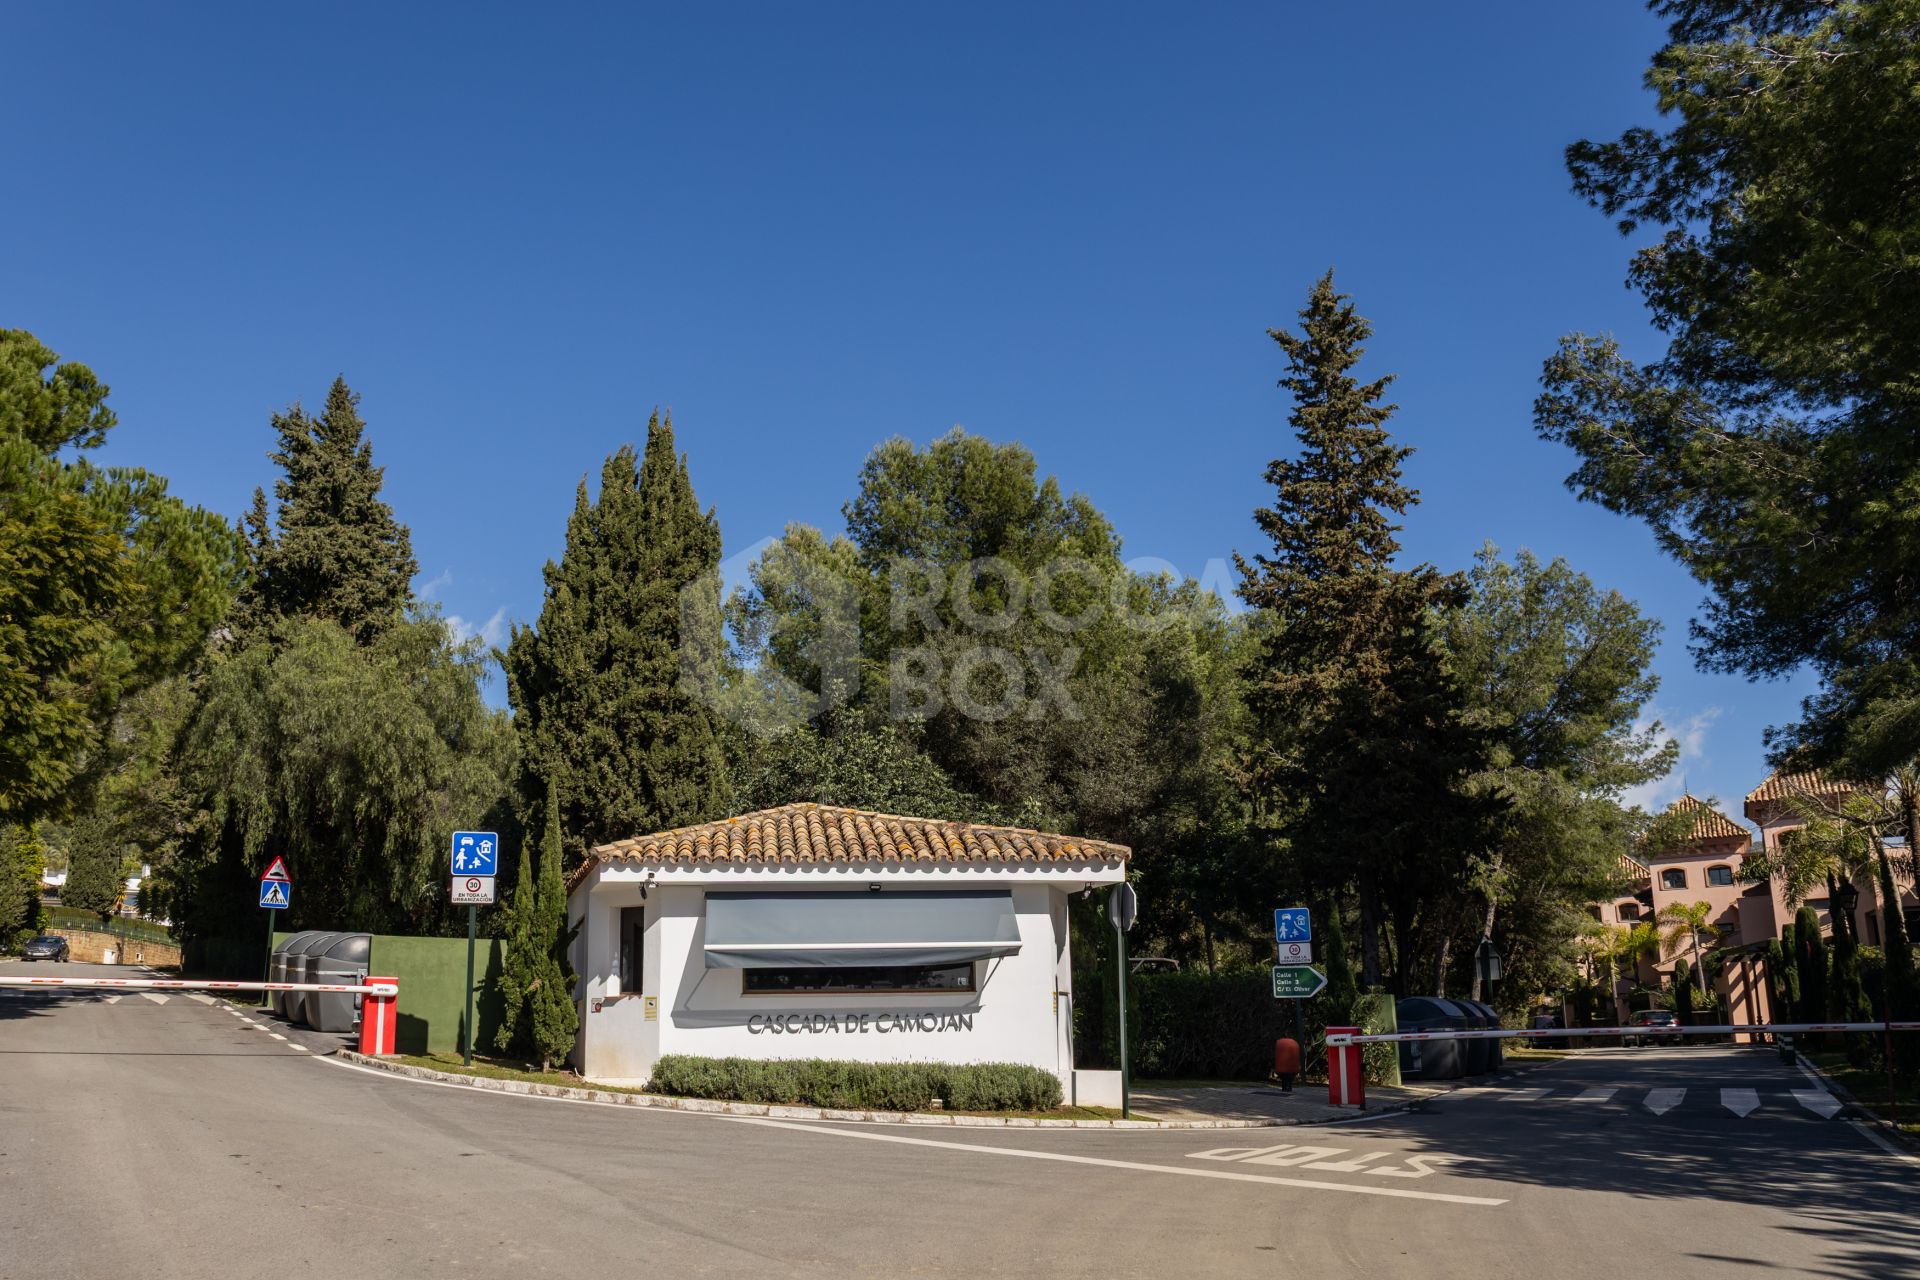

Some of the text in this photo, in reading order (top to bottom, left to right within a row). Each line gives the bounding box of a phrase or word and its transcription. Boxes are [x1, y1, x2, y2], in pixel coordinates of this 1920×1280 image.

[747, 1012, 973, 1034] CASCADA DE CAMOJAN
[1184, 1143, 1463, 1178] STOP
